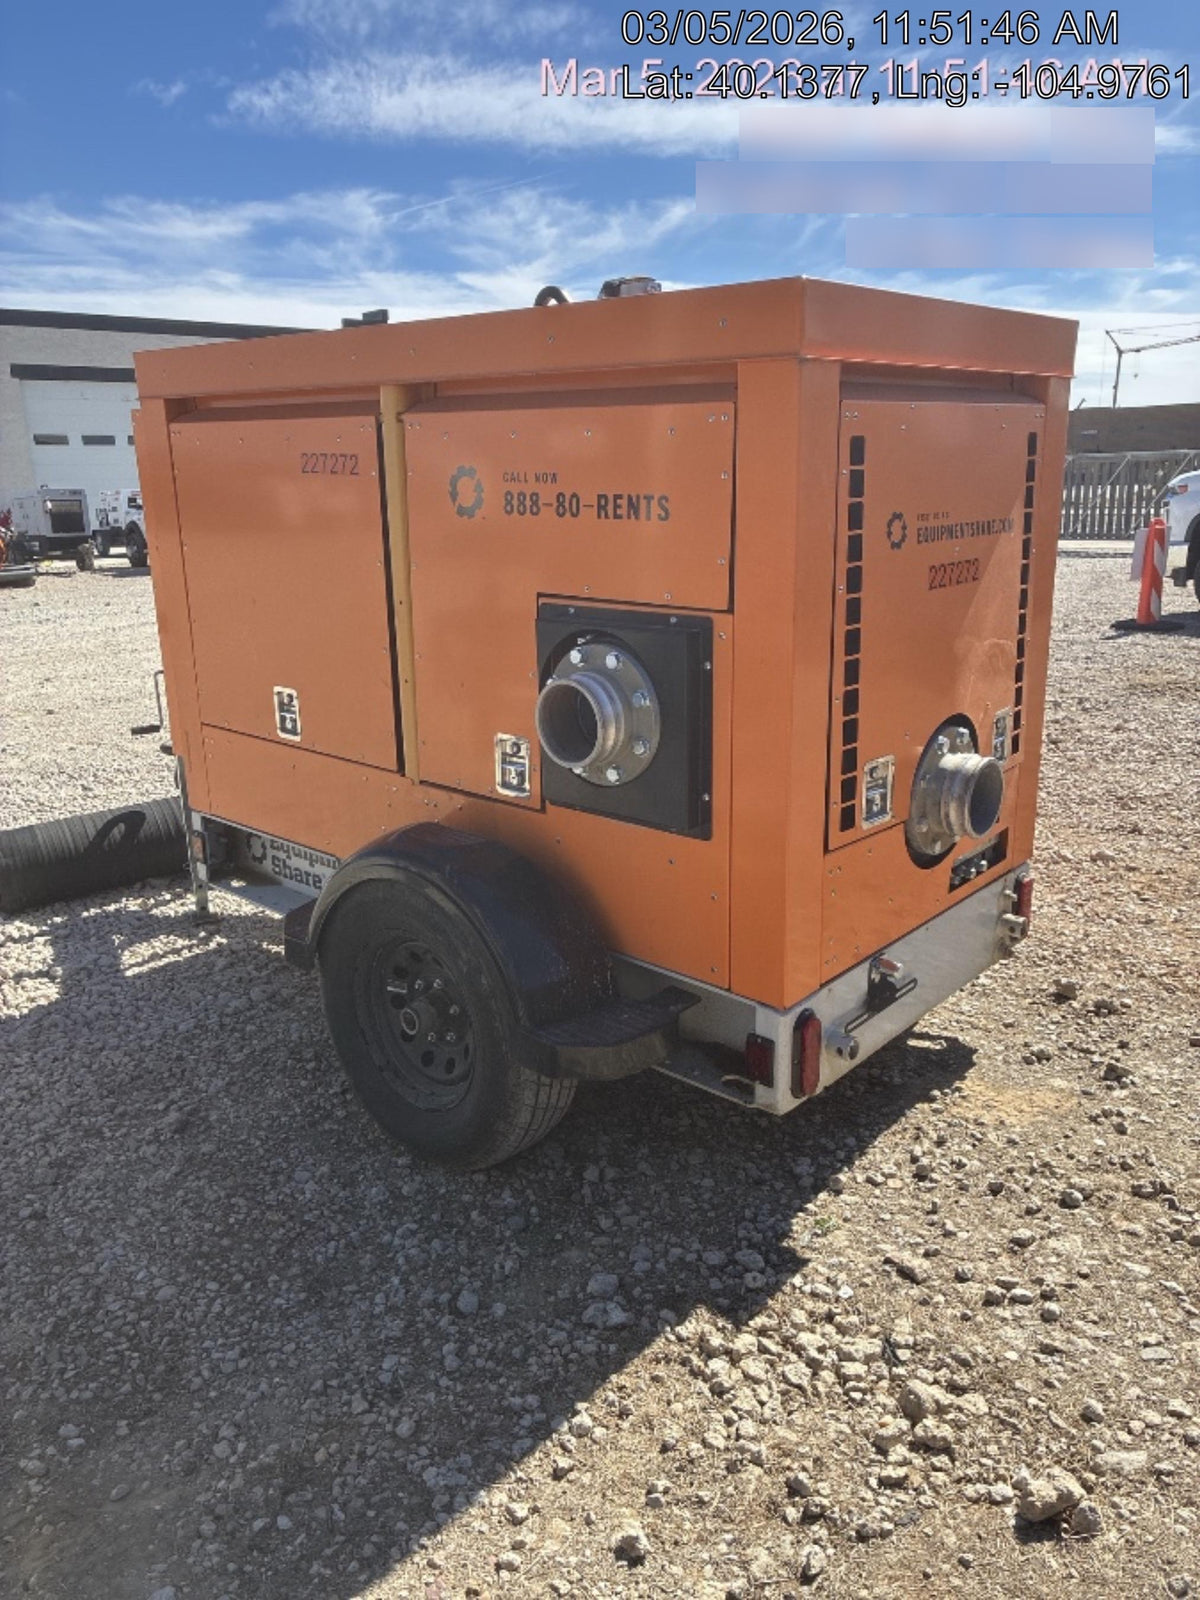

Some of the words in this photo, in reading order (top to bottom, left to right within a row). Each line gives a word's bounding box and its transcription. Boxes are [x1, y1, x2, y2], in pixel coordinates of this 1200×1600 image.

[301, 453, 359, 475] 227272
[503, 472, 529, 483] CALL
[534, 472, 559, 484] NOW
[504, 490, 671, 521] 888-80-RENTS
[928, 558, 980, 591] 227272
[271, 854, 323, 889] Share
